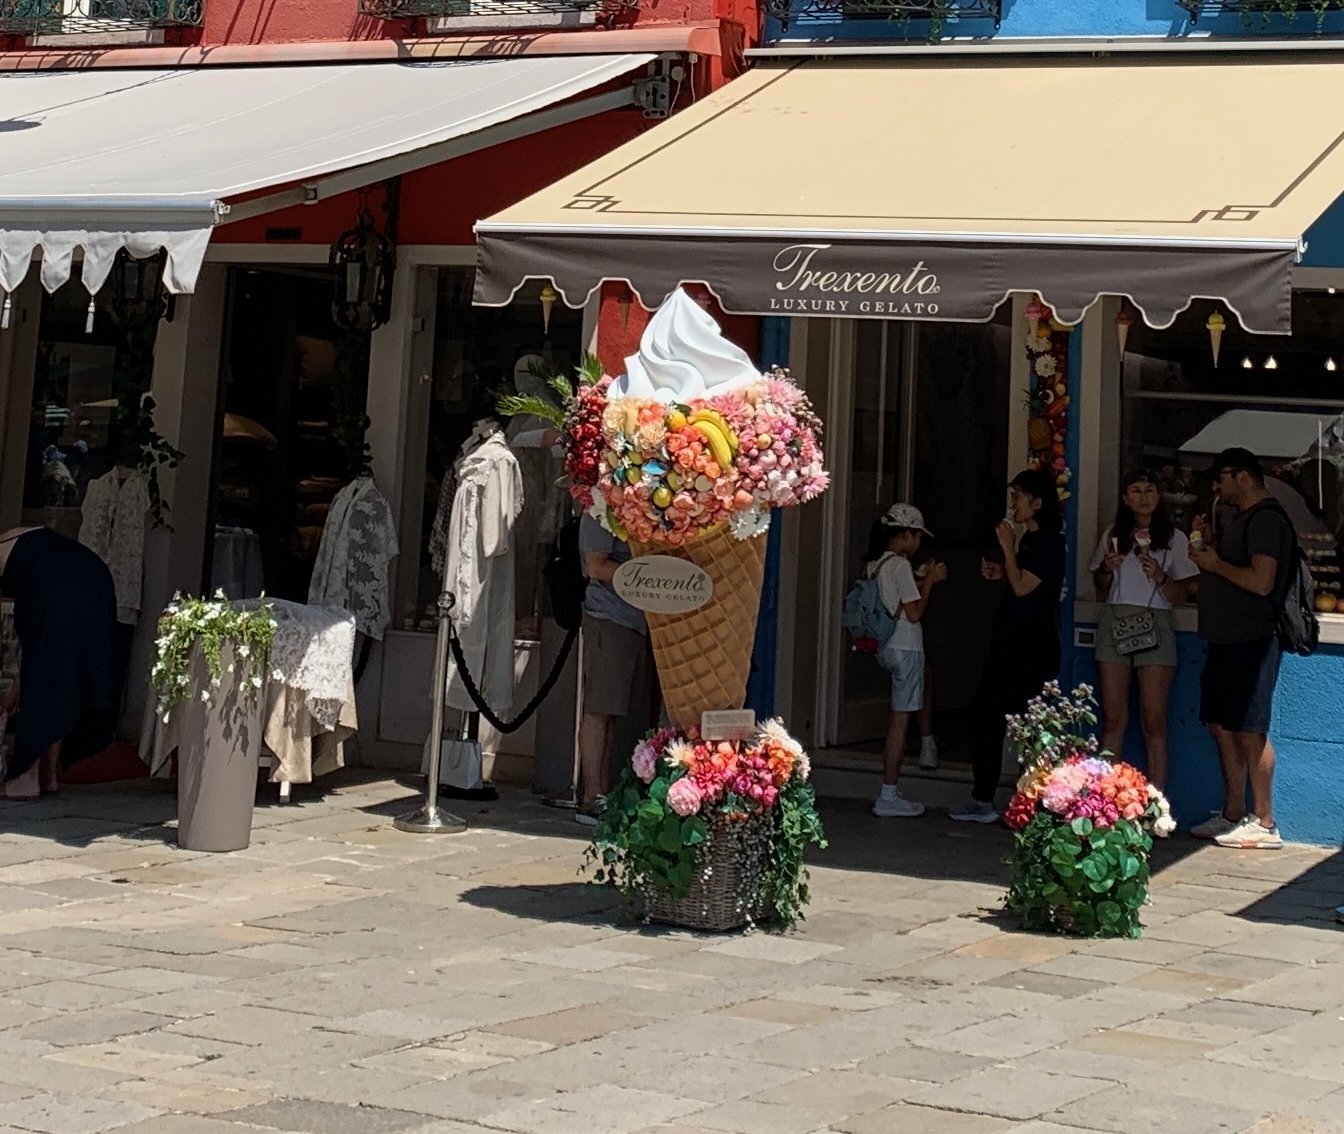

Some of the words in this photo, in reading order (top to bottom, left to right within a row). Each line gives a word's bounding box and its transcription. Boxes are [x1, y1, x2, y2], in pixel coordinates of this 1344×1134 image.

[773, 243, 939, 294] Trexento
[770, 298, 849, 312] LUXURY
[859, 300, 939, 314] GELATO
[621, 590, 661, 600] LUXURY
